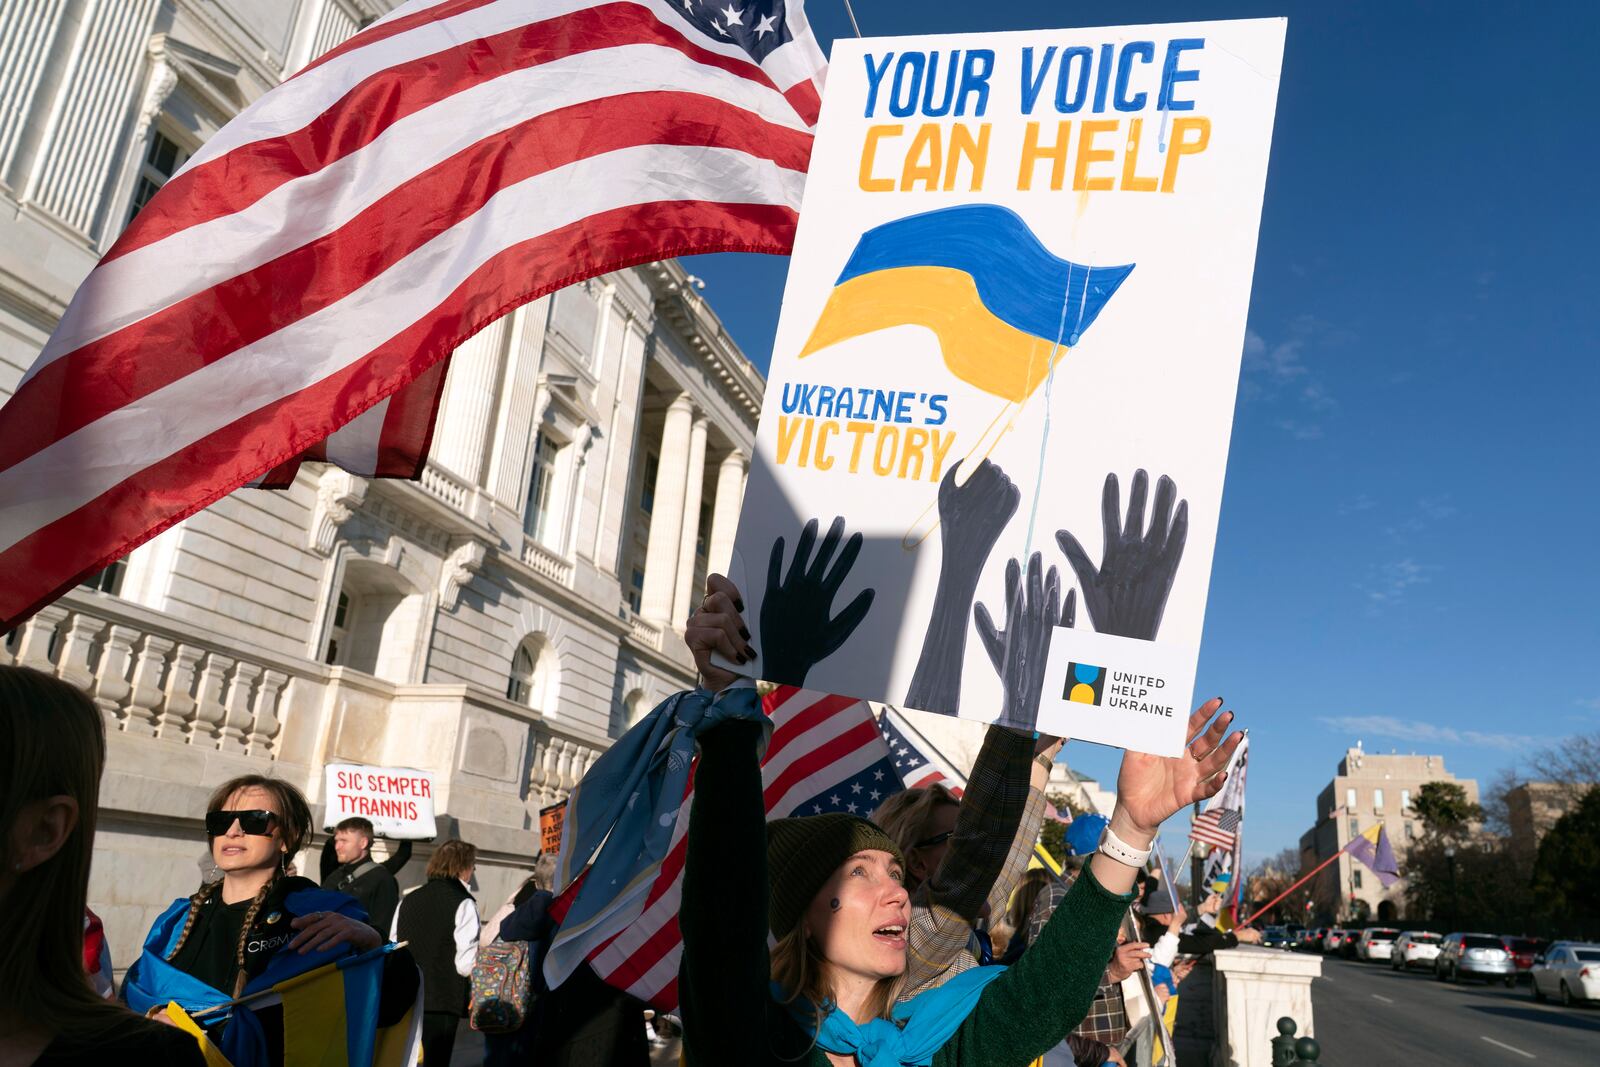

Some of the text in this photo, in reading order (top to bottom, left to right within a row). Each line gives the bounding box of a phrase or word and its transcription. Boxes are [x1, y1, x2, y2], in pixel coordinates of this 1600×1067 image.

[864, 38, 1205, 118] YOUR VOICE
[858, 116, 1211, 193] CAN HELP
[781, 383, 948, 425] UKRAINE'S
[776, 416, 956, 483] VICTORY
[1111, 684, 1148, 698] HELP
[1113, 671, 1165, 689] UNITED
[1109, 697, 1173, 717] UKRAINE
[337, 771, 431, 799] SIC SEMPER
[337, 794, 418, 821] TYRANNIS
